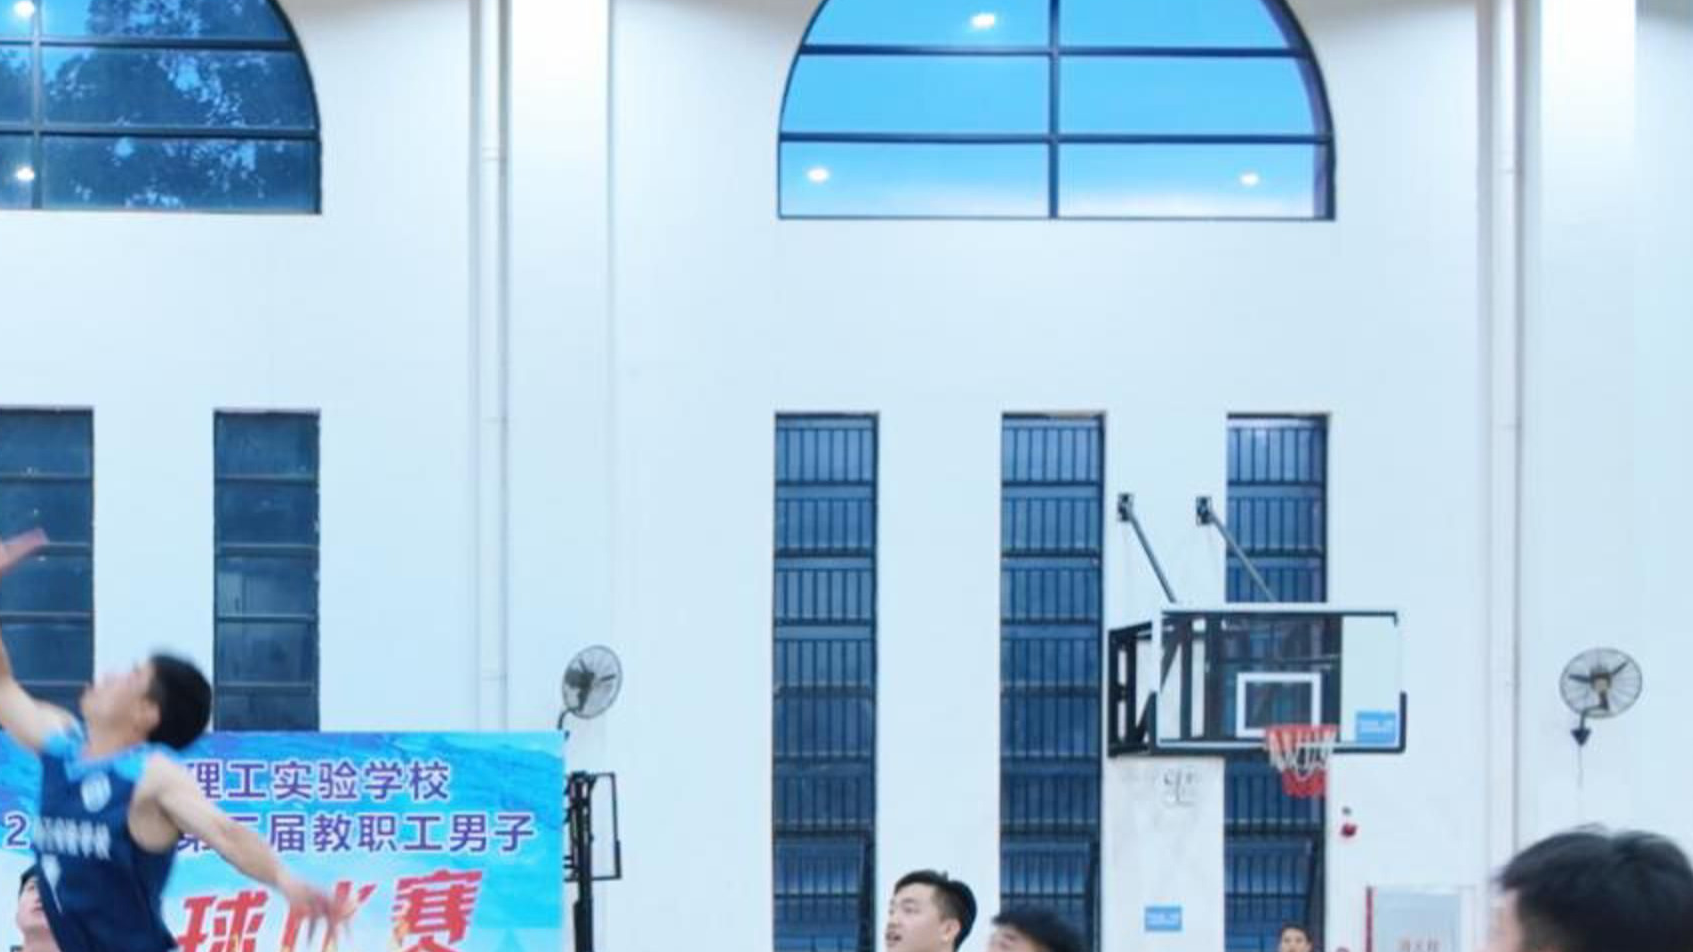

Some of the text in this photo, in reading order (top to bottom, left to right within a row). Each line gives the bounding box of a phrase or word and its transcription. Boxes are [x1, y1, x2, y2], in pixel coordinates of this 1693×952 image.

[187, 761, 450, 801] 理工实验学校
